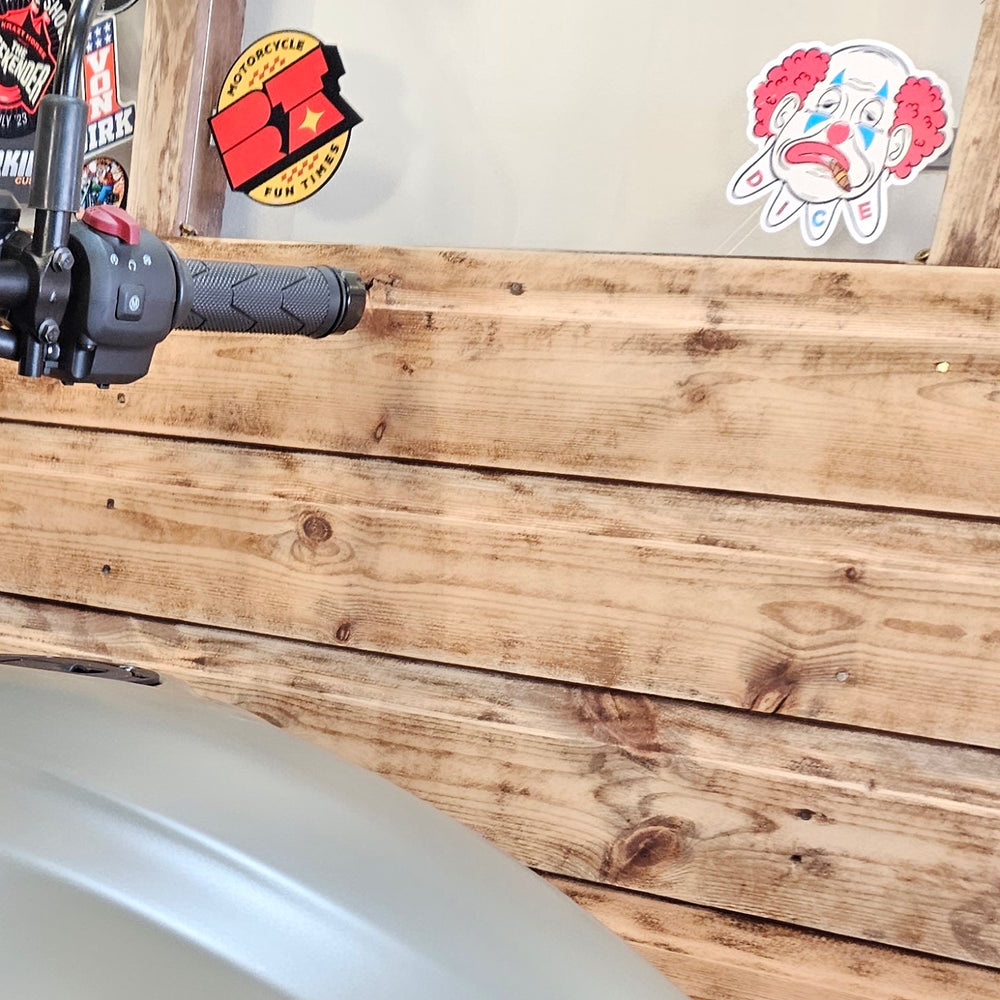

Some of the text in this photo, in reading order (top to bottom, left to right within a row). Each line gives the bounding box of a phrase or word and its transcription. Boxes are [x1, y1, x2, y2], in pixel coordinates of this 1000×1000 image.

[11, 40, 28, 59] THE
[227, 38, 305, 97] MOTORCYCLE
[86, 49, 113, 121] VON
[85, 107, 134, 153] IRK
[264, 143, 340, 198] FUN TIMES
